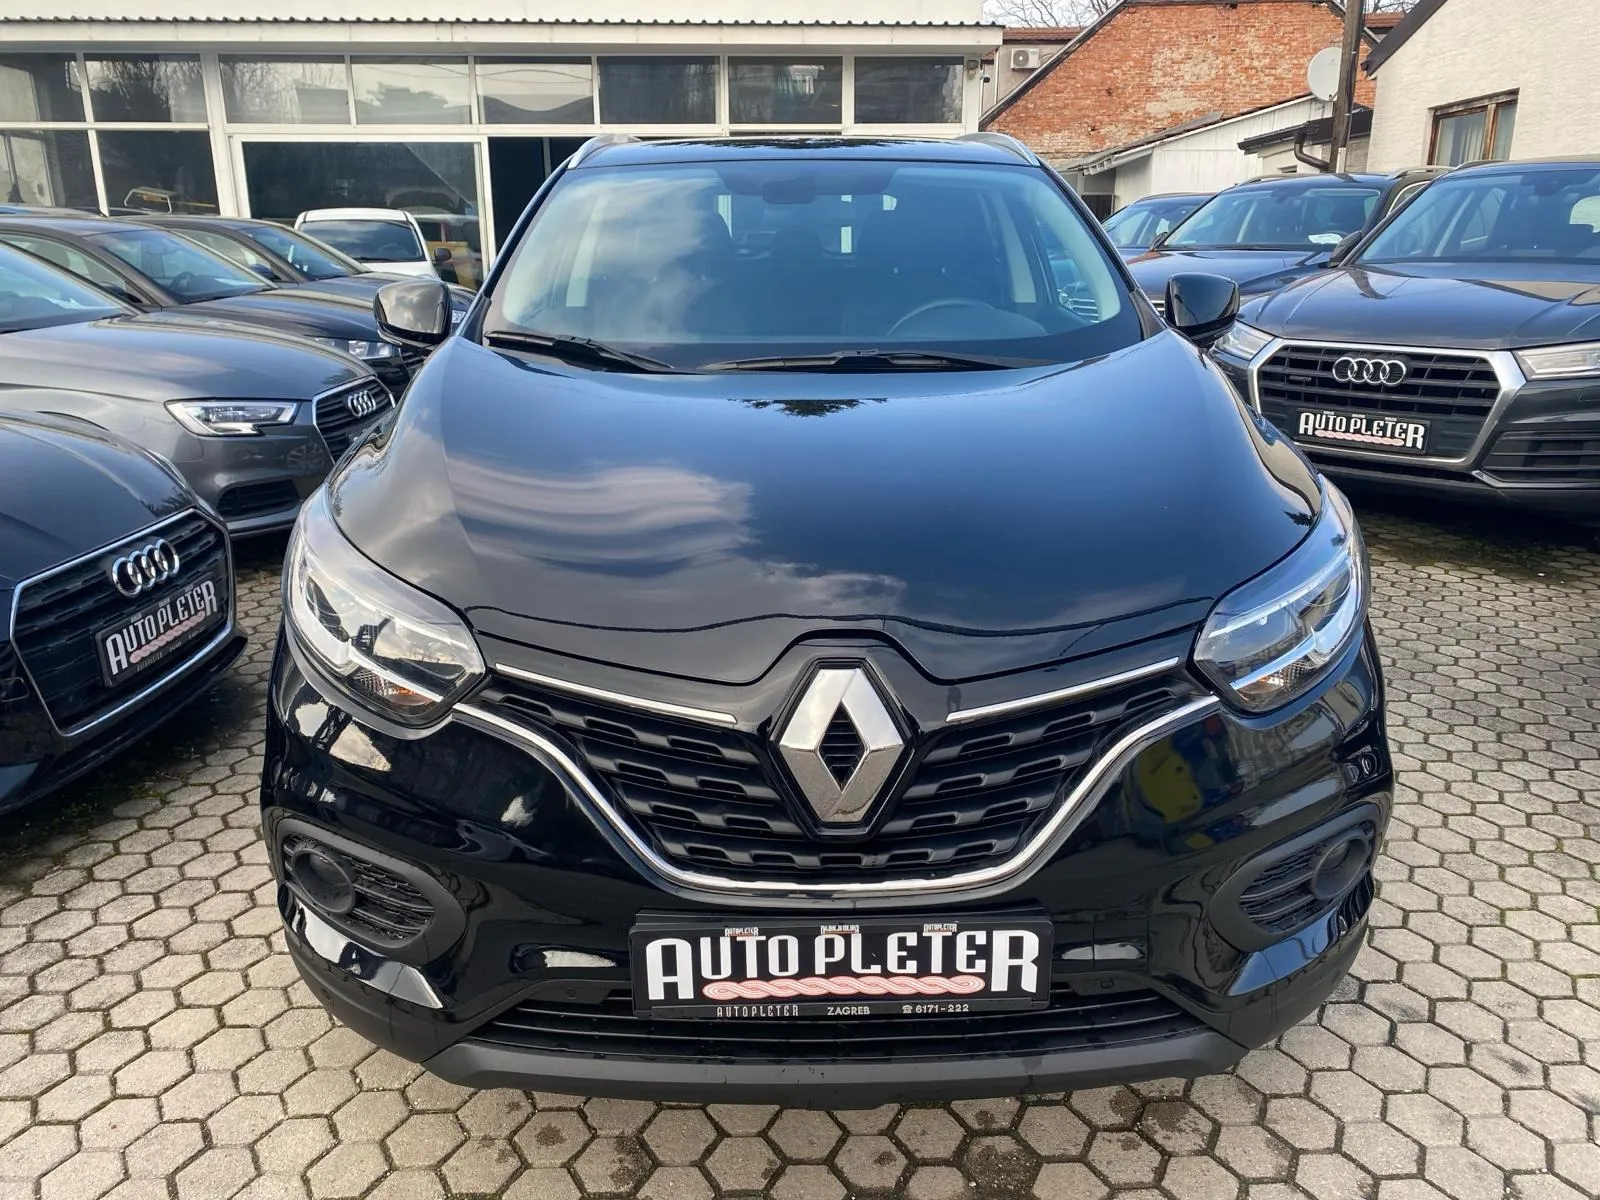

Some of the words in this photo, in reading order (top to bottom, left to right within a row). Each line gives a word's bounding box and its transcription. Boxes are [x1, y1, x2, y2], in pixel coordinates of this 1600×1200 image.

[1299, 412, 1347, 436] AUTO
[1349, 418, 1425, 449] PLETER
[105, 614, 157, 675] AUTO
[156, 580, 218, 633] PLETER
[645, 935, 799, 1000] AUTO
[814, 930, 1040, 993] PLETER
[716, 1005, 799, 1017] AUTOPLETER
[827, 1005, 871, 1016] ZAGREB
